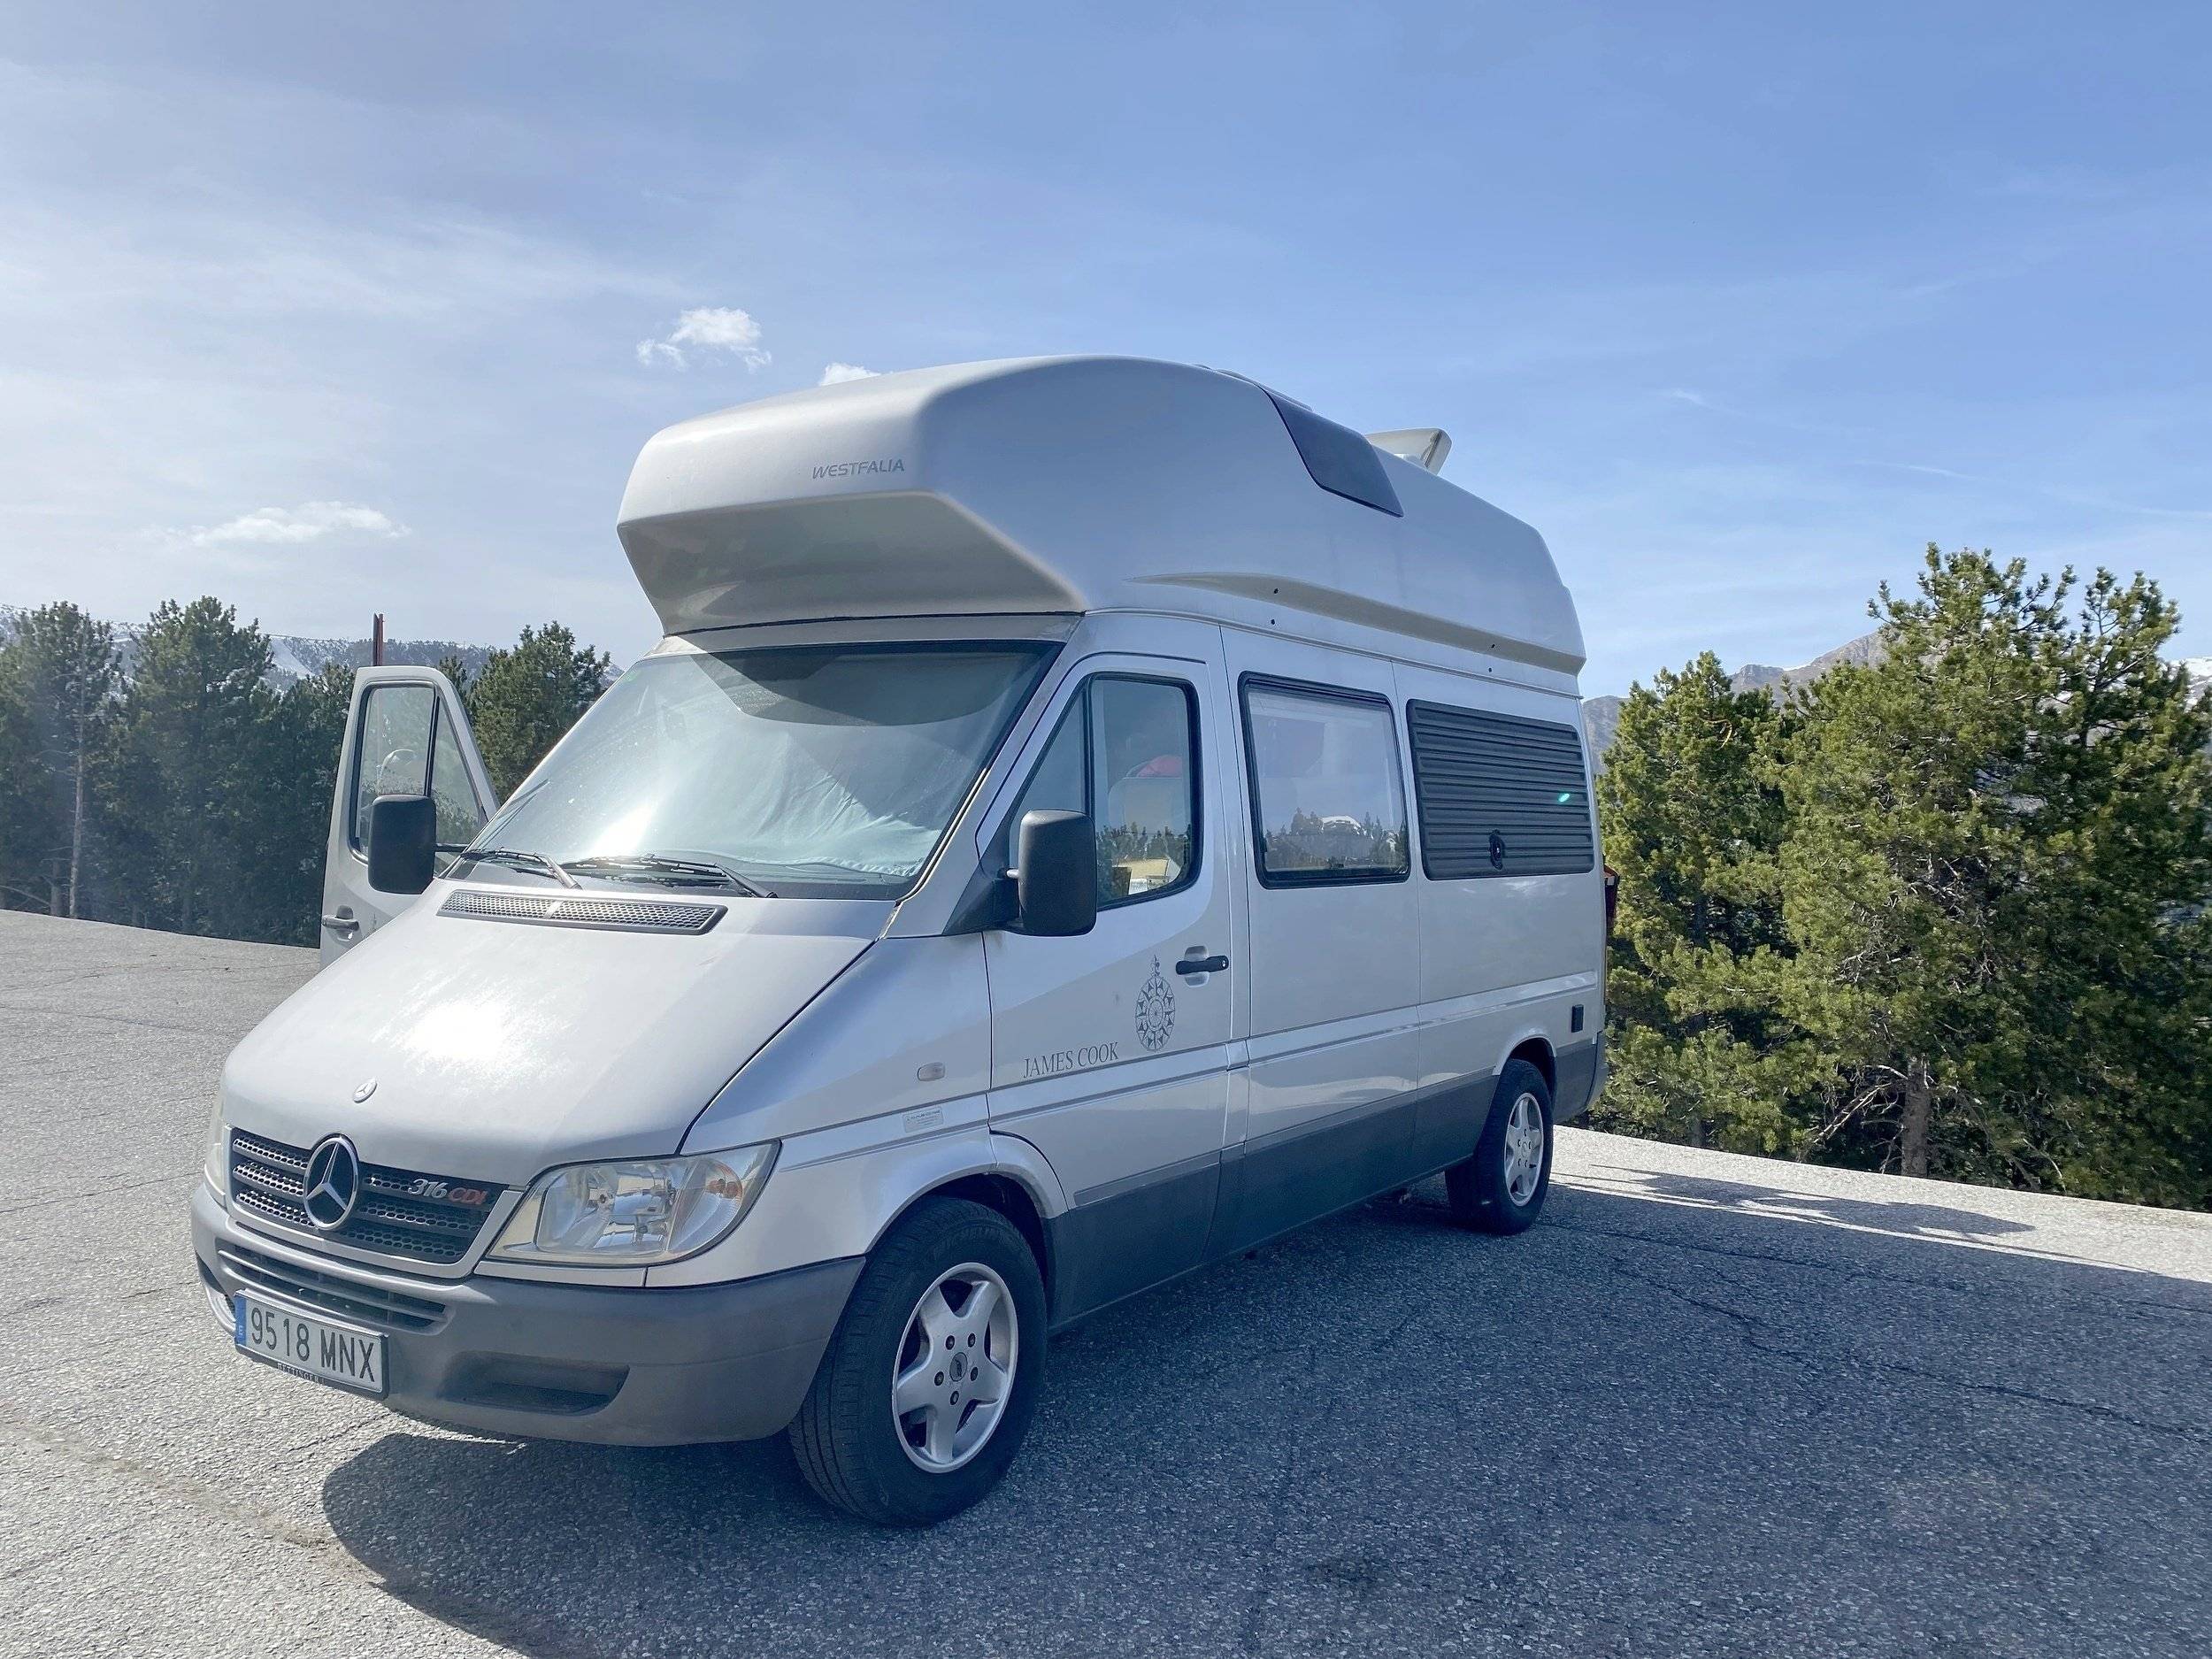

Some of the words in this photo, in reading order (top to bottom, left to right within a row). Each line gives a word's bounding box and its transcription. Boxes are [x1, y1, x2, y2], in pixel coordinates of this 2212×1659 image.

[812, 458, 905, 480] WESTFALIA
[1023, 1050, 1073, 1079] JAMES
[1077, 1041, 1119, 1067] COOK
[407, 1178, 449, 1199] 316
[447, 1187, 488, 1205] CDI
[251, 1307, 311, 1362] 9518
[320, 1328, 375, 1383] MNX
